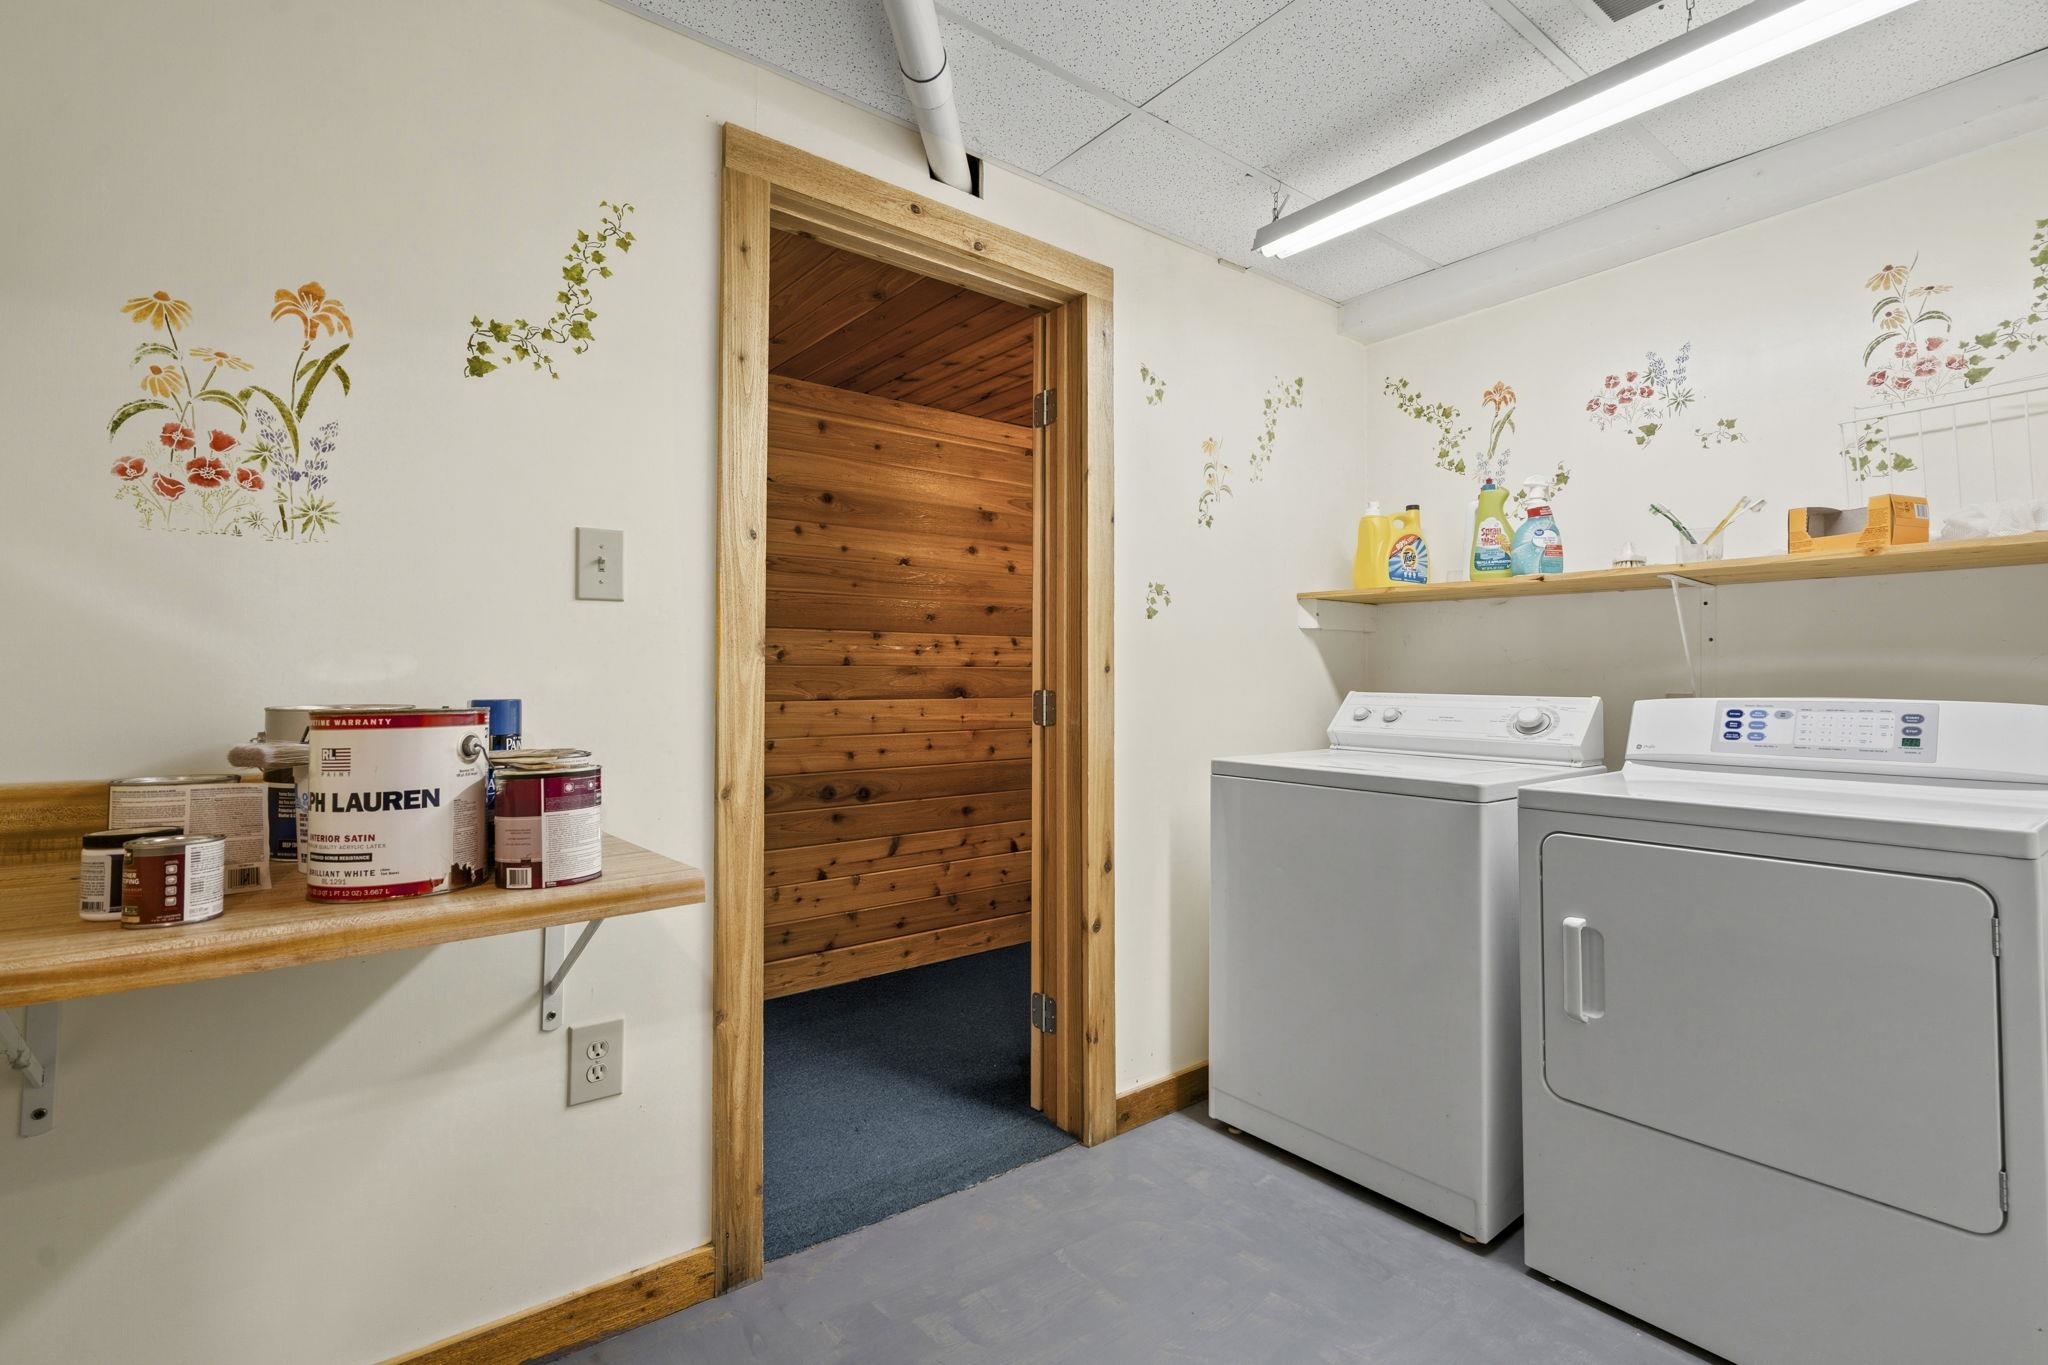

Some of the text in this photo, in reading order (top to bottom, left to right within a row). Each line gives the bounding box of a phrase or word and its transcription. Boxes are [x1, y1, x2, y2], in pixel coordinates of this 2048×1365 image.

[334, 718, 392, 726] WARRANTY
[322, 749, 336, 760] RL
[332, 788, 440, 813] LAUREN
[344, 834, 376, 842] SATIN
[344, 869, 376, 877] WHITE
